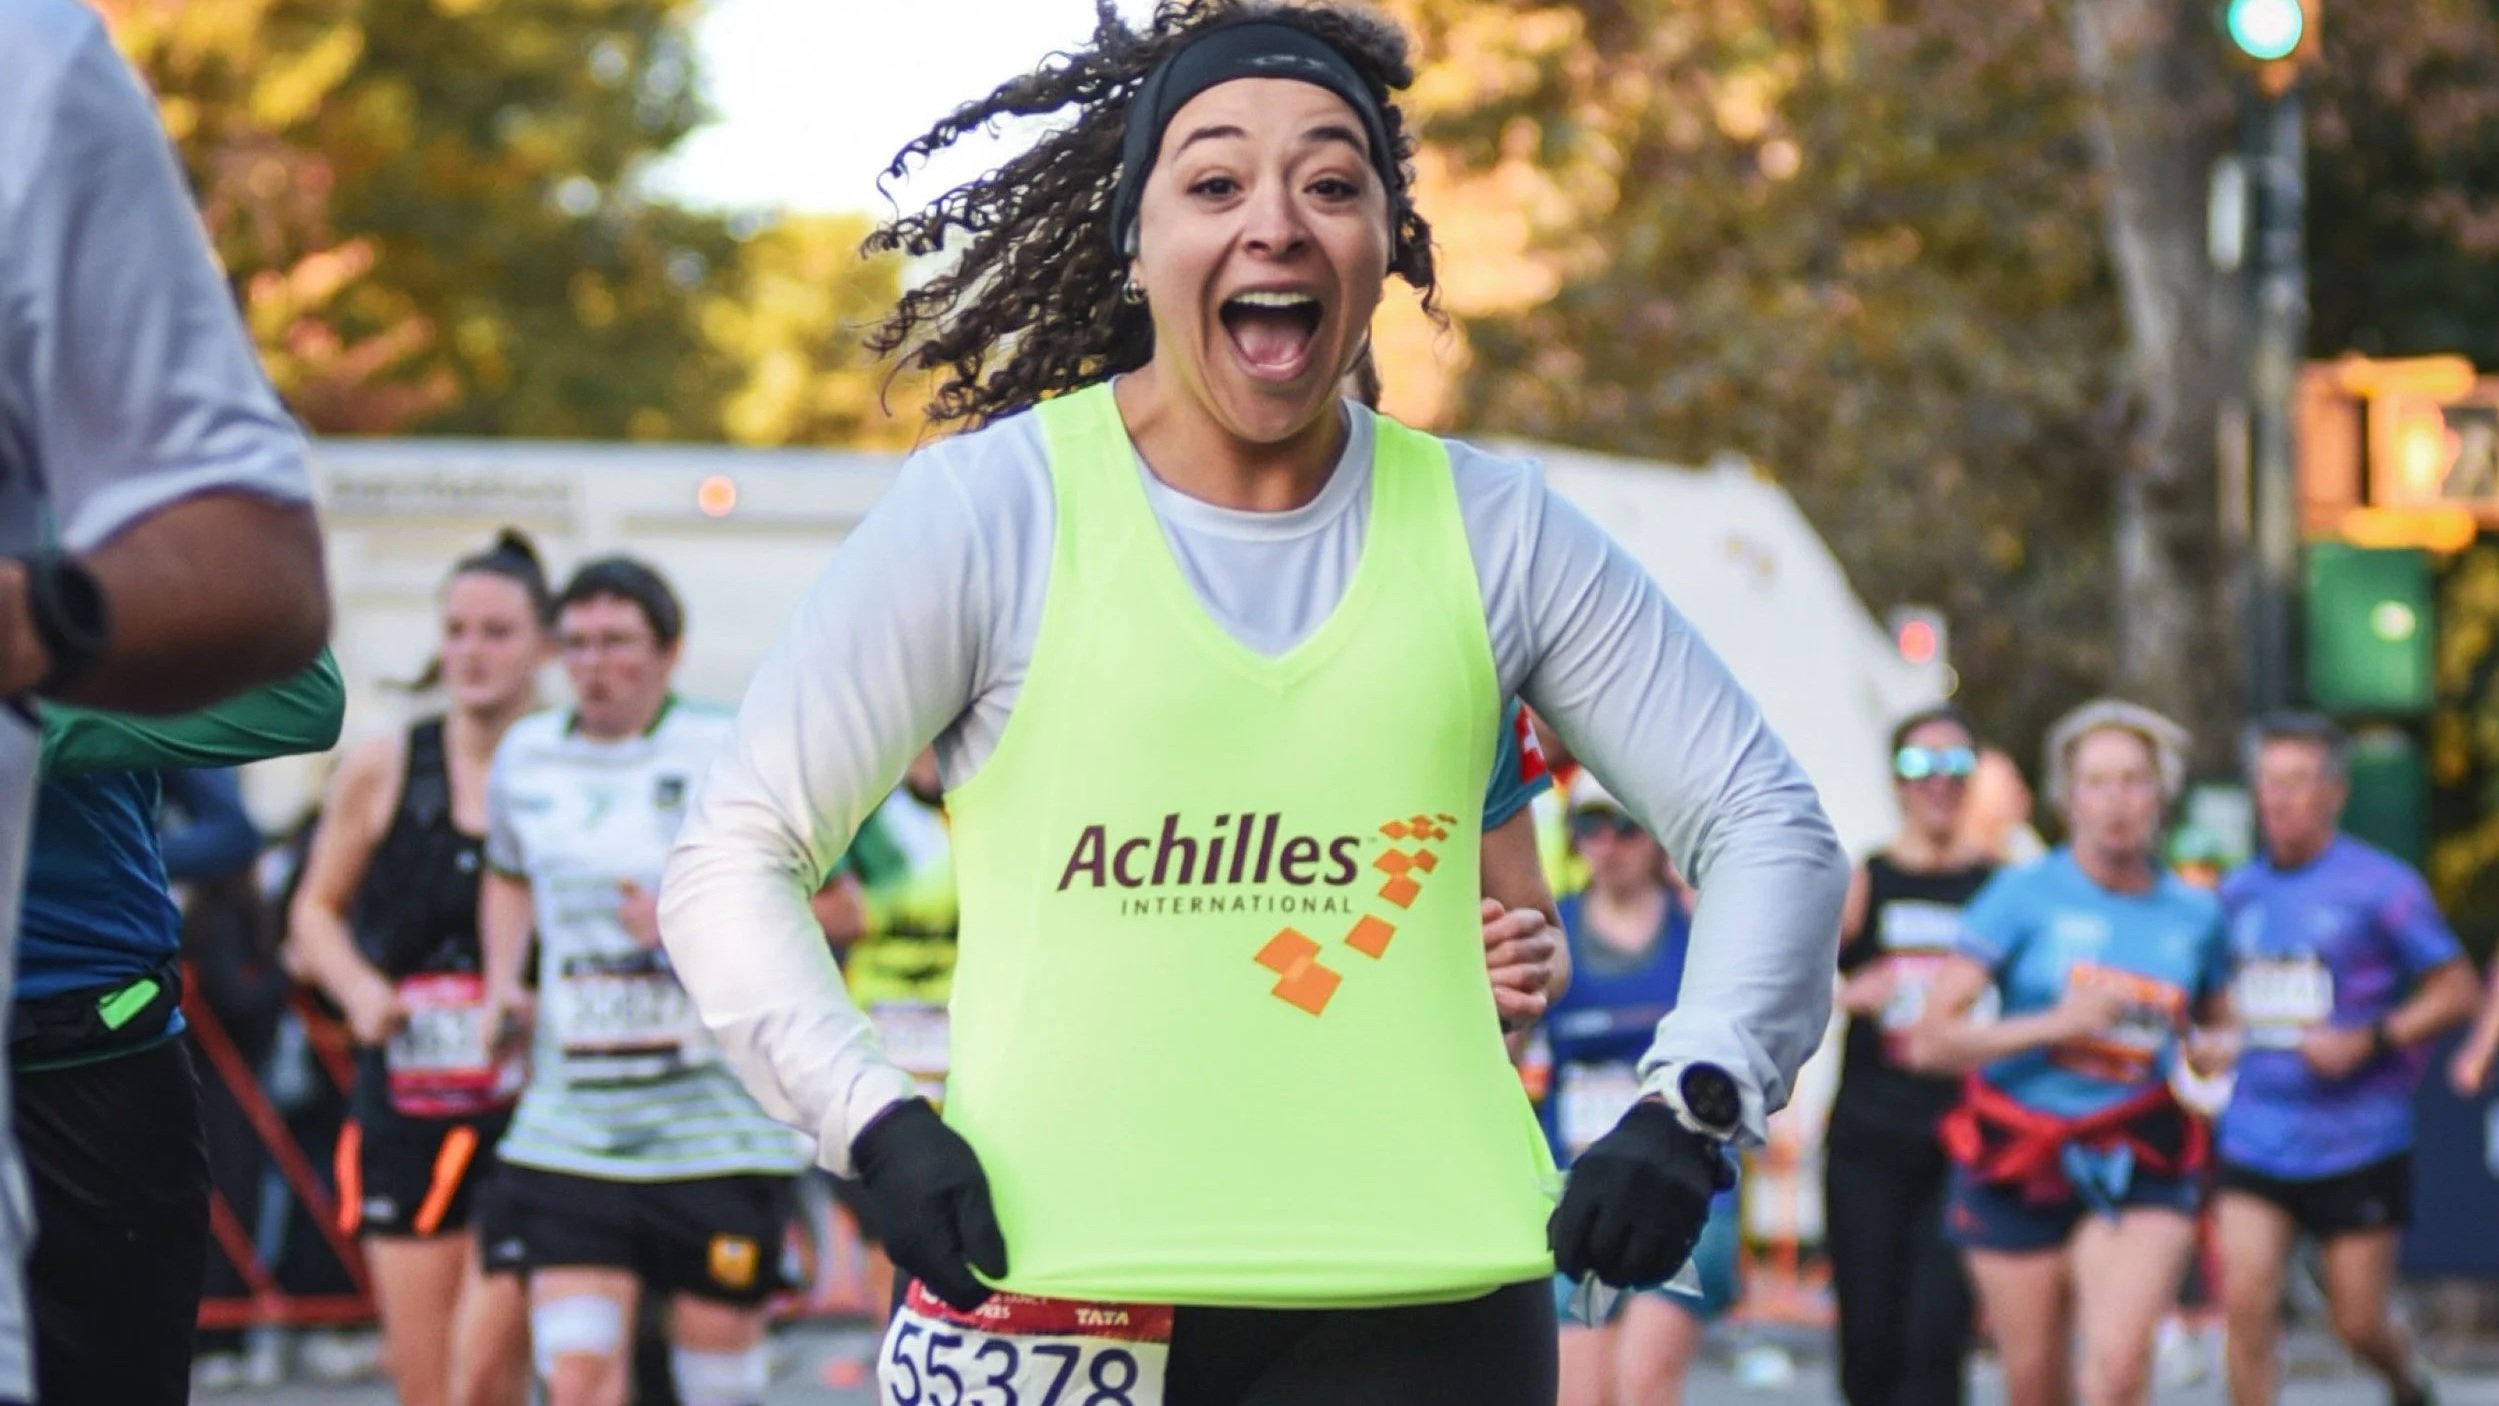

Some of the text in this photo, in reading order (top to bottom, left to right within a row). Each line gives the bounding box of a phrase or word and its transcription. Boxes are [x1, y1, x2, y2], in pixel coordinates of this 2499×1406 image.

[1056, 812, 1361, 891] Achilles
[1121, 895, 1353, 916] INTERNATIONAL
[1074, 1308, 1130, 1327] TATA
[890, 1321, 1139, 1406] 55378
